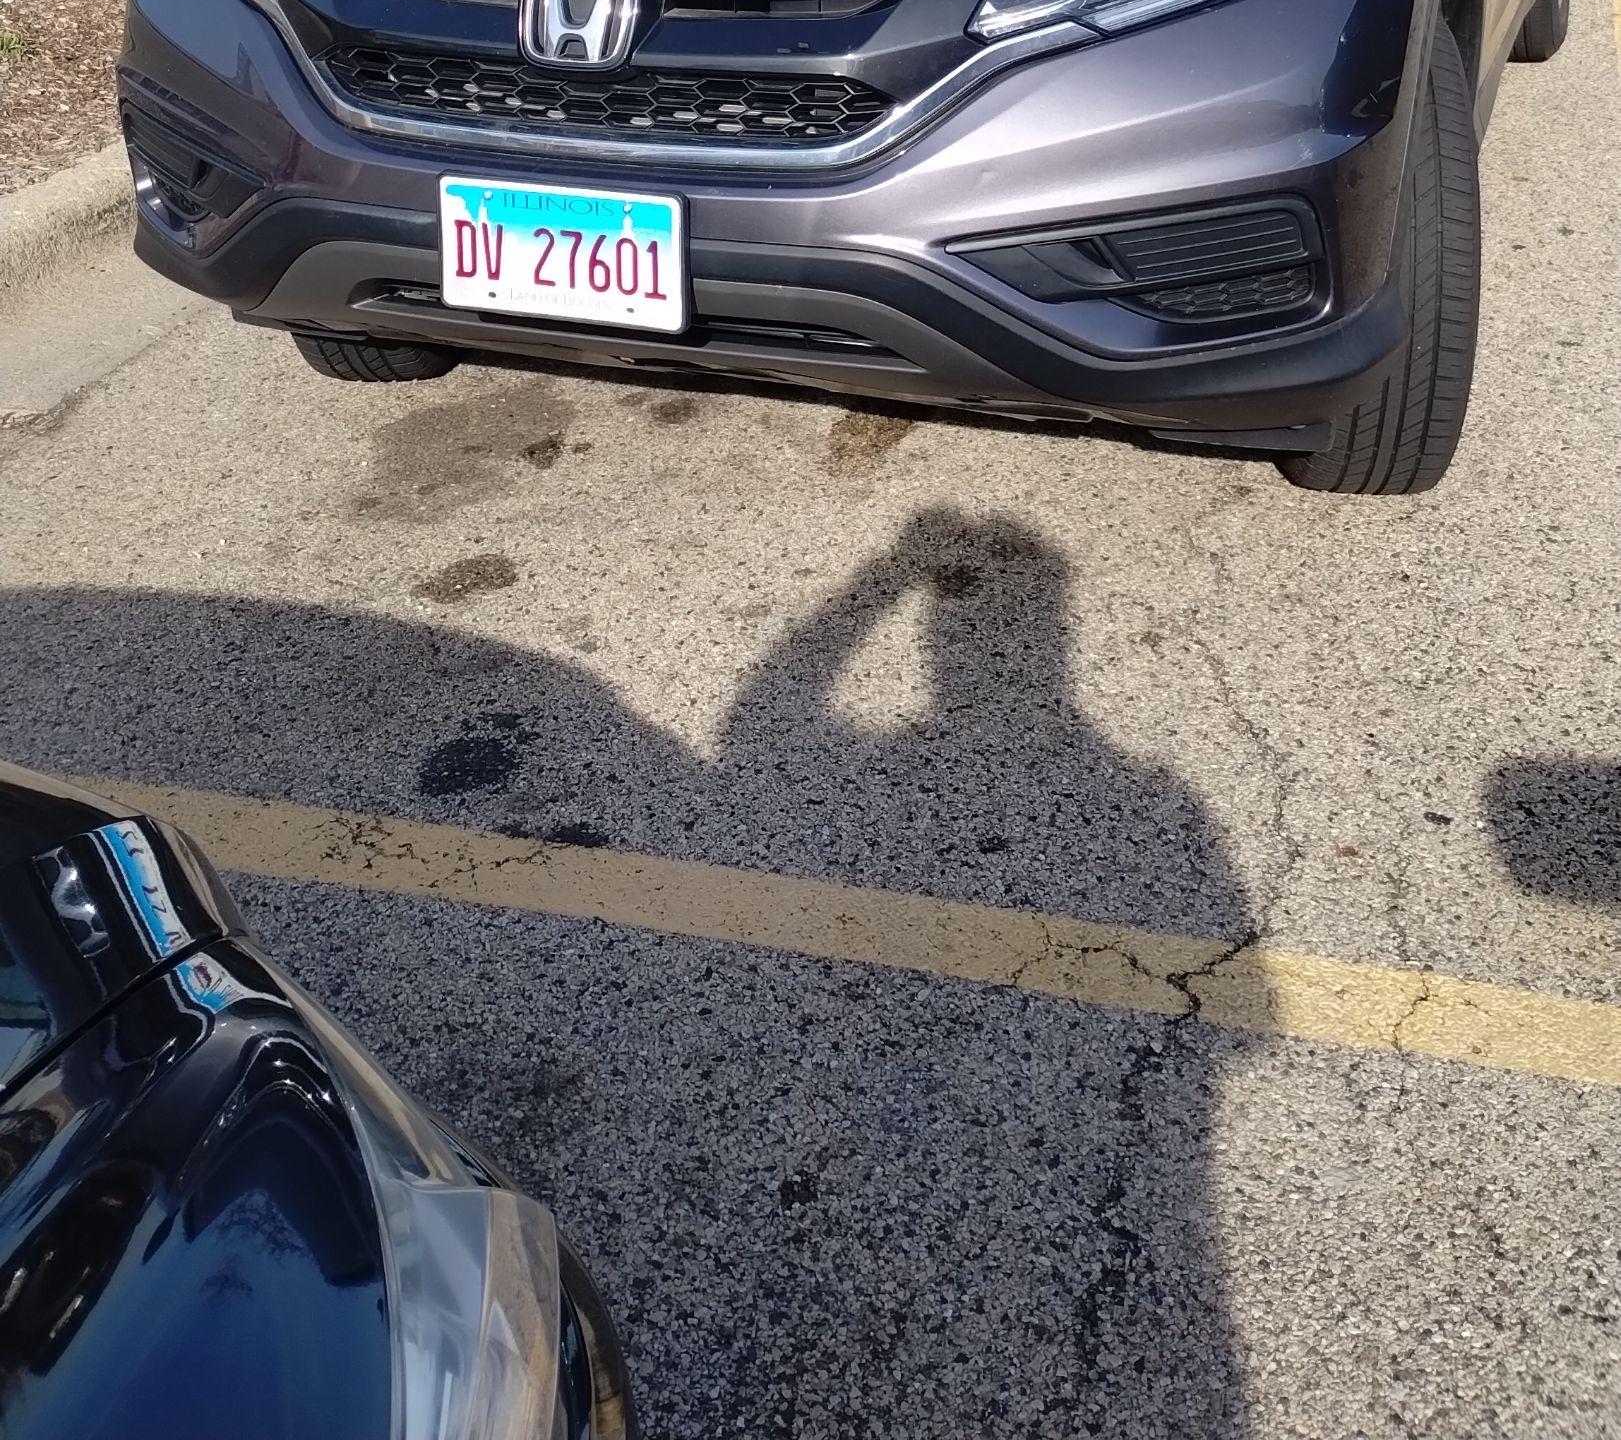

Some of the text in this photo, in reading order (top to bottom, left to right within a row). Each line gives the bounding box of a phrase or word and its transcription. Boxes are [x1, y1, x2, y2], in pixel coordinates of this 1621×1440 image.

[503, 192, 614, 218] ILLINOIS
[454, 219, 667, 300] DV 27601
